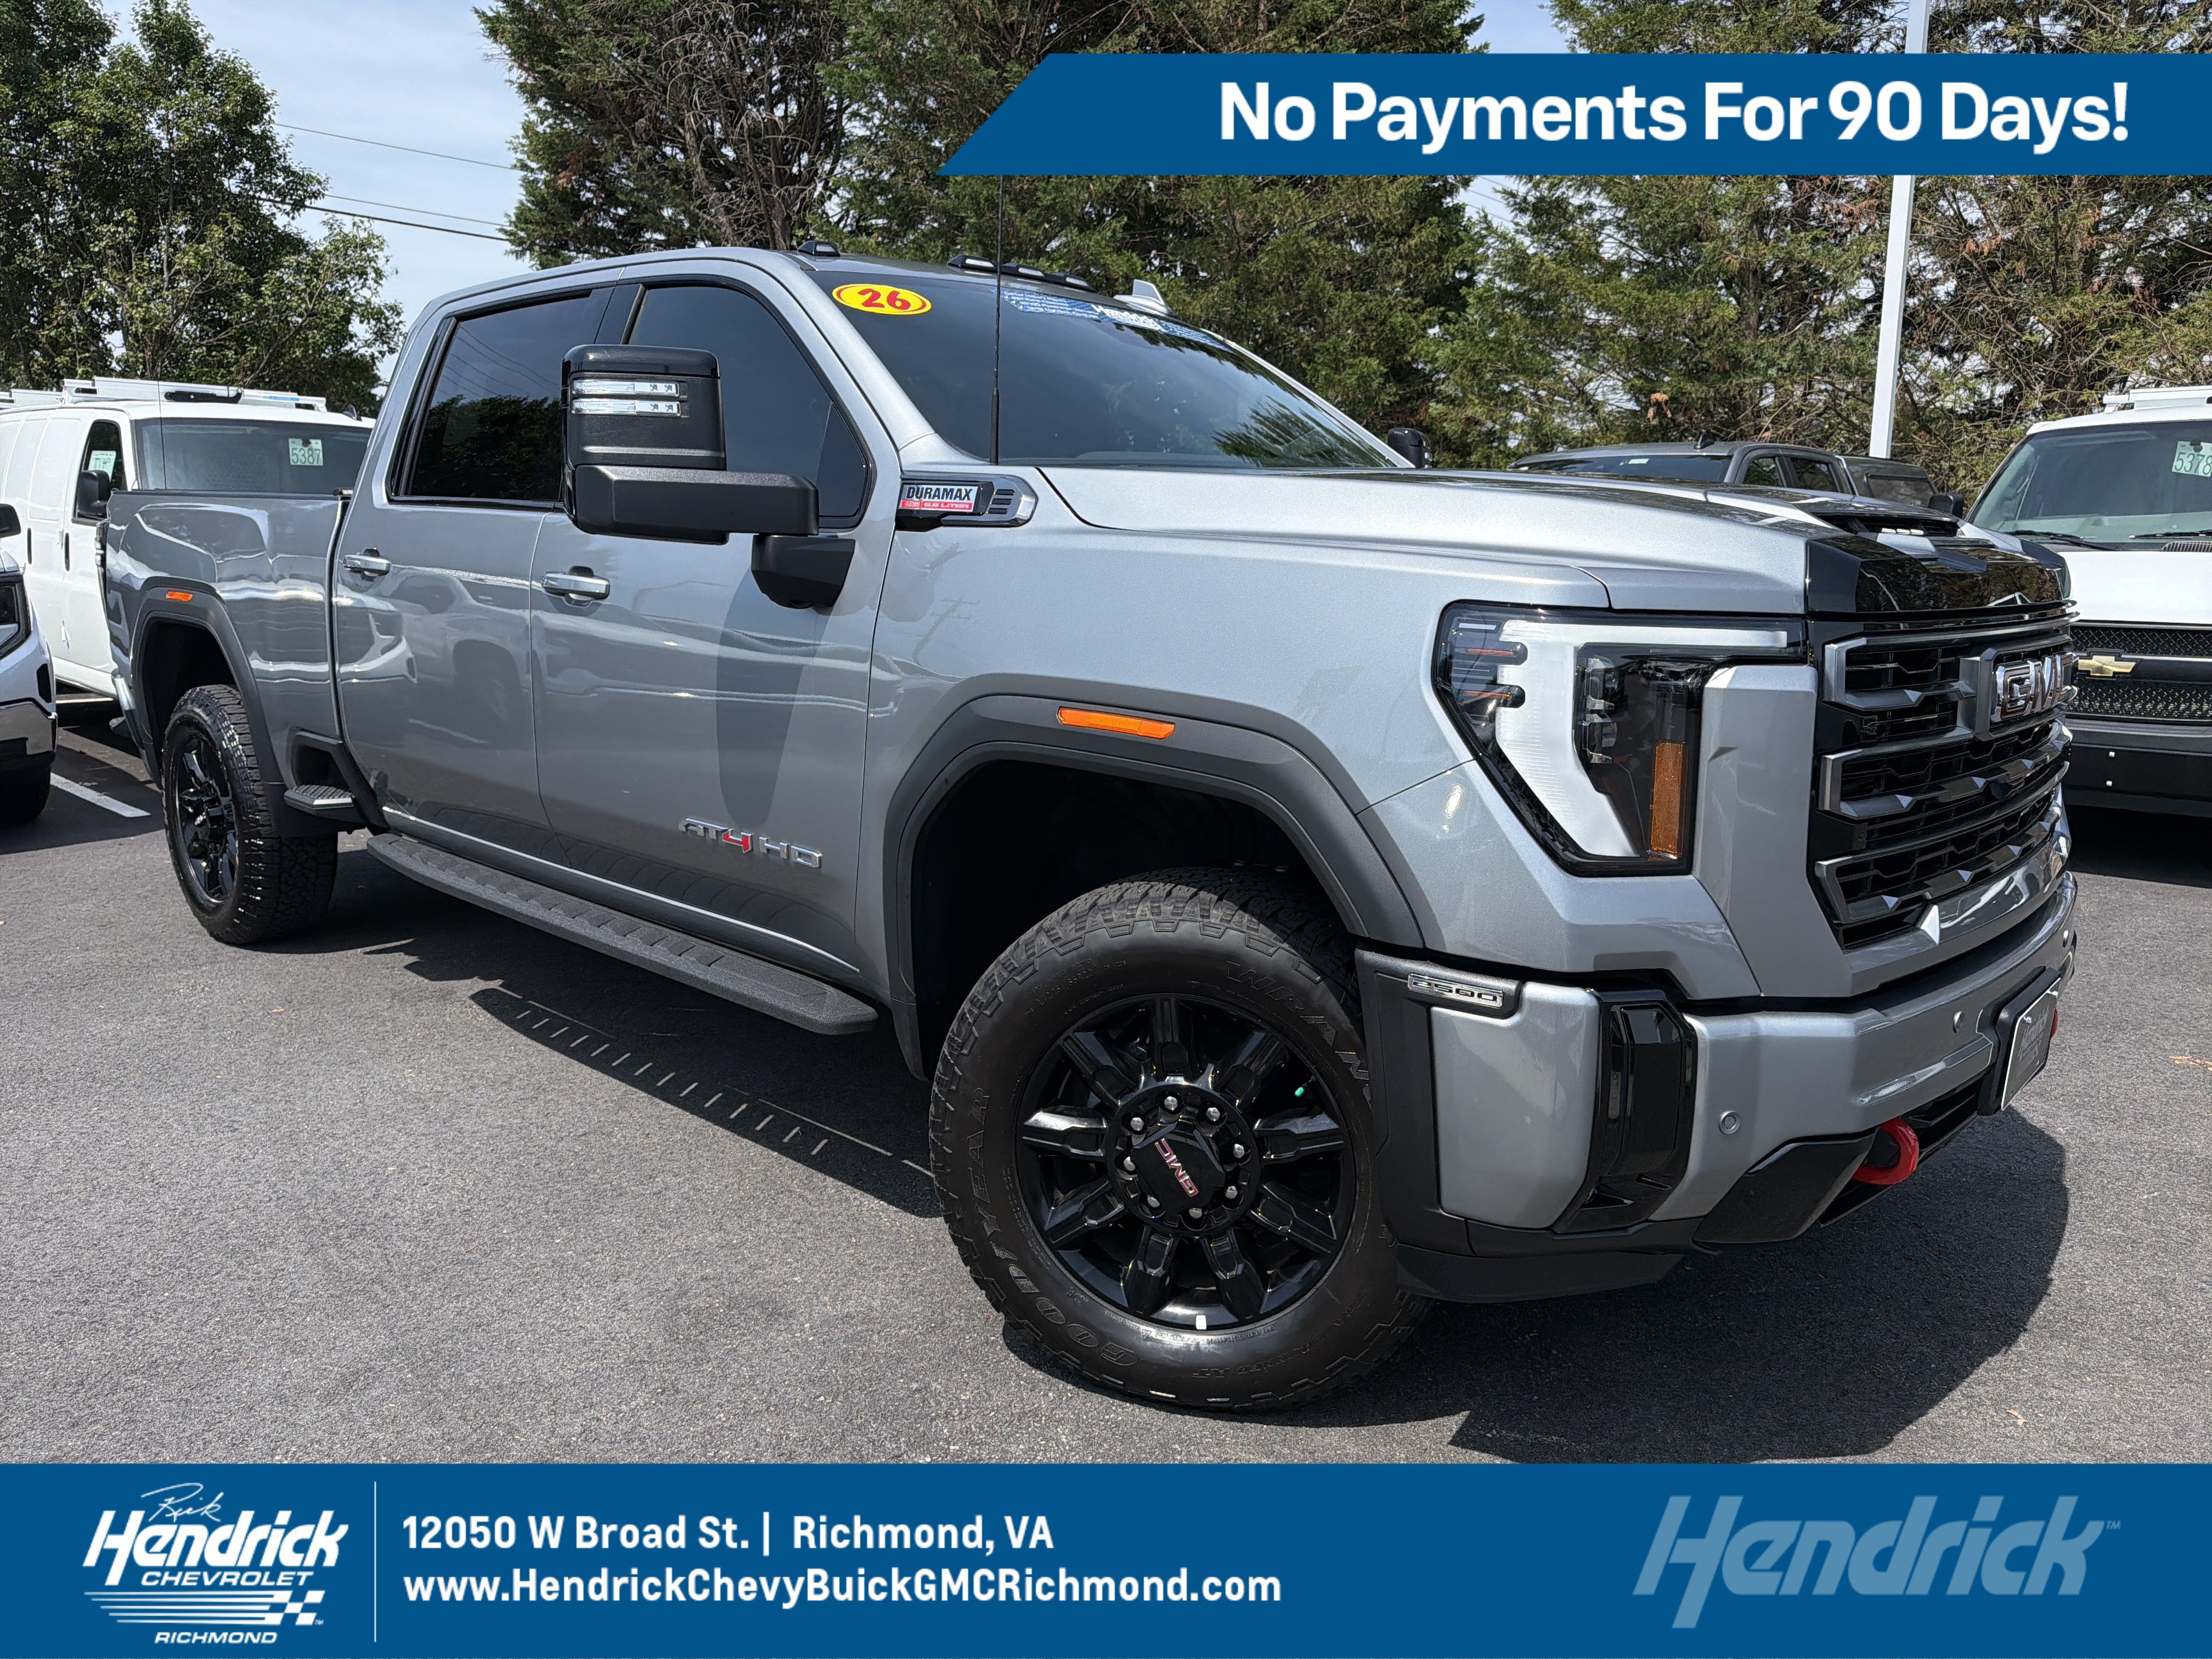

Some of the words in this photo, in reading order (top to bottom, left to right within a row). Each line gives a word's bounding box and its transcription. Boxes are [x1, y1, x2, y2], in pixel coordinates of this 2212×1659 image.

[857, 288, 911, 311] 26
[291, 447, 321, 465] 5387
[2174, 452, 2212, 476] 5378
[906, 486, 973, 501] DURAMAX
[1993, 652, 2078, 723] GMC
[1154, 1137, 1200, 1198] GMC
